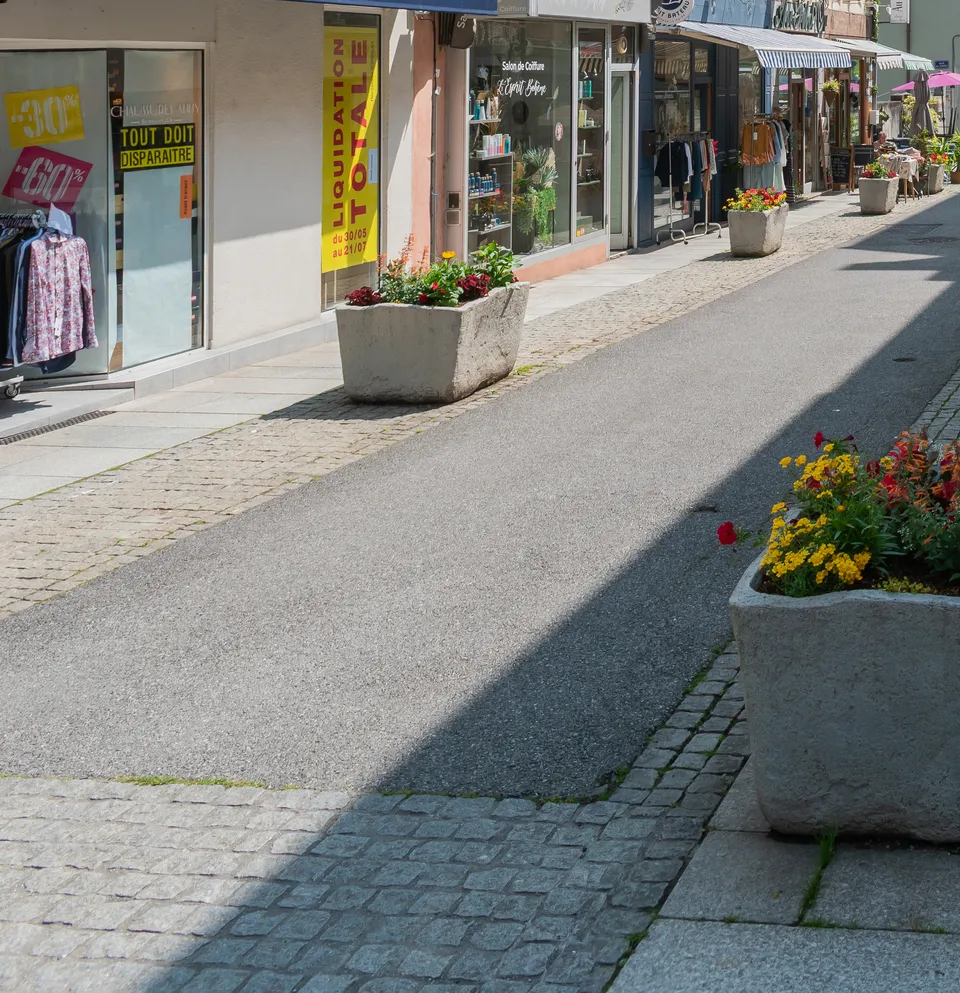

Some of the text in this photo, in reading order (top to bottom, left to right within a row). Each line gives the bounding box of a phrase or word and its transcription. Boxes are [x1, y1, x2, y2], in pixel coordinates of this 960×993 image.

[502, 61, 545, 71] Salon de Coiffure
[110, 104, 174, 118] CHAUSSURES
[120, 125, 194, 147] TOUT DOIT
[333, 38, 367, 228] LIQUIDATION TOTALE
[121, 147, 192, 167] DISPARAITRE
[332, 228, 367, 244] du 30/05
[332, 241, 367, 258] au 21/07
